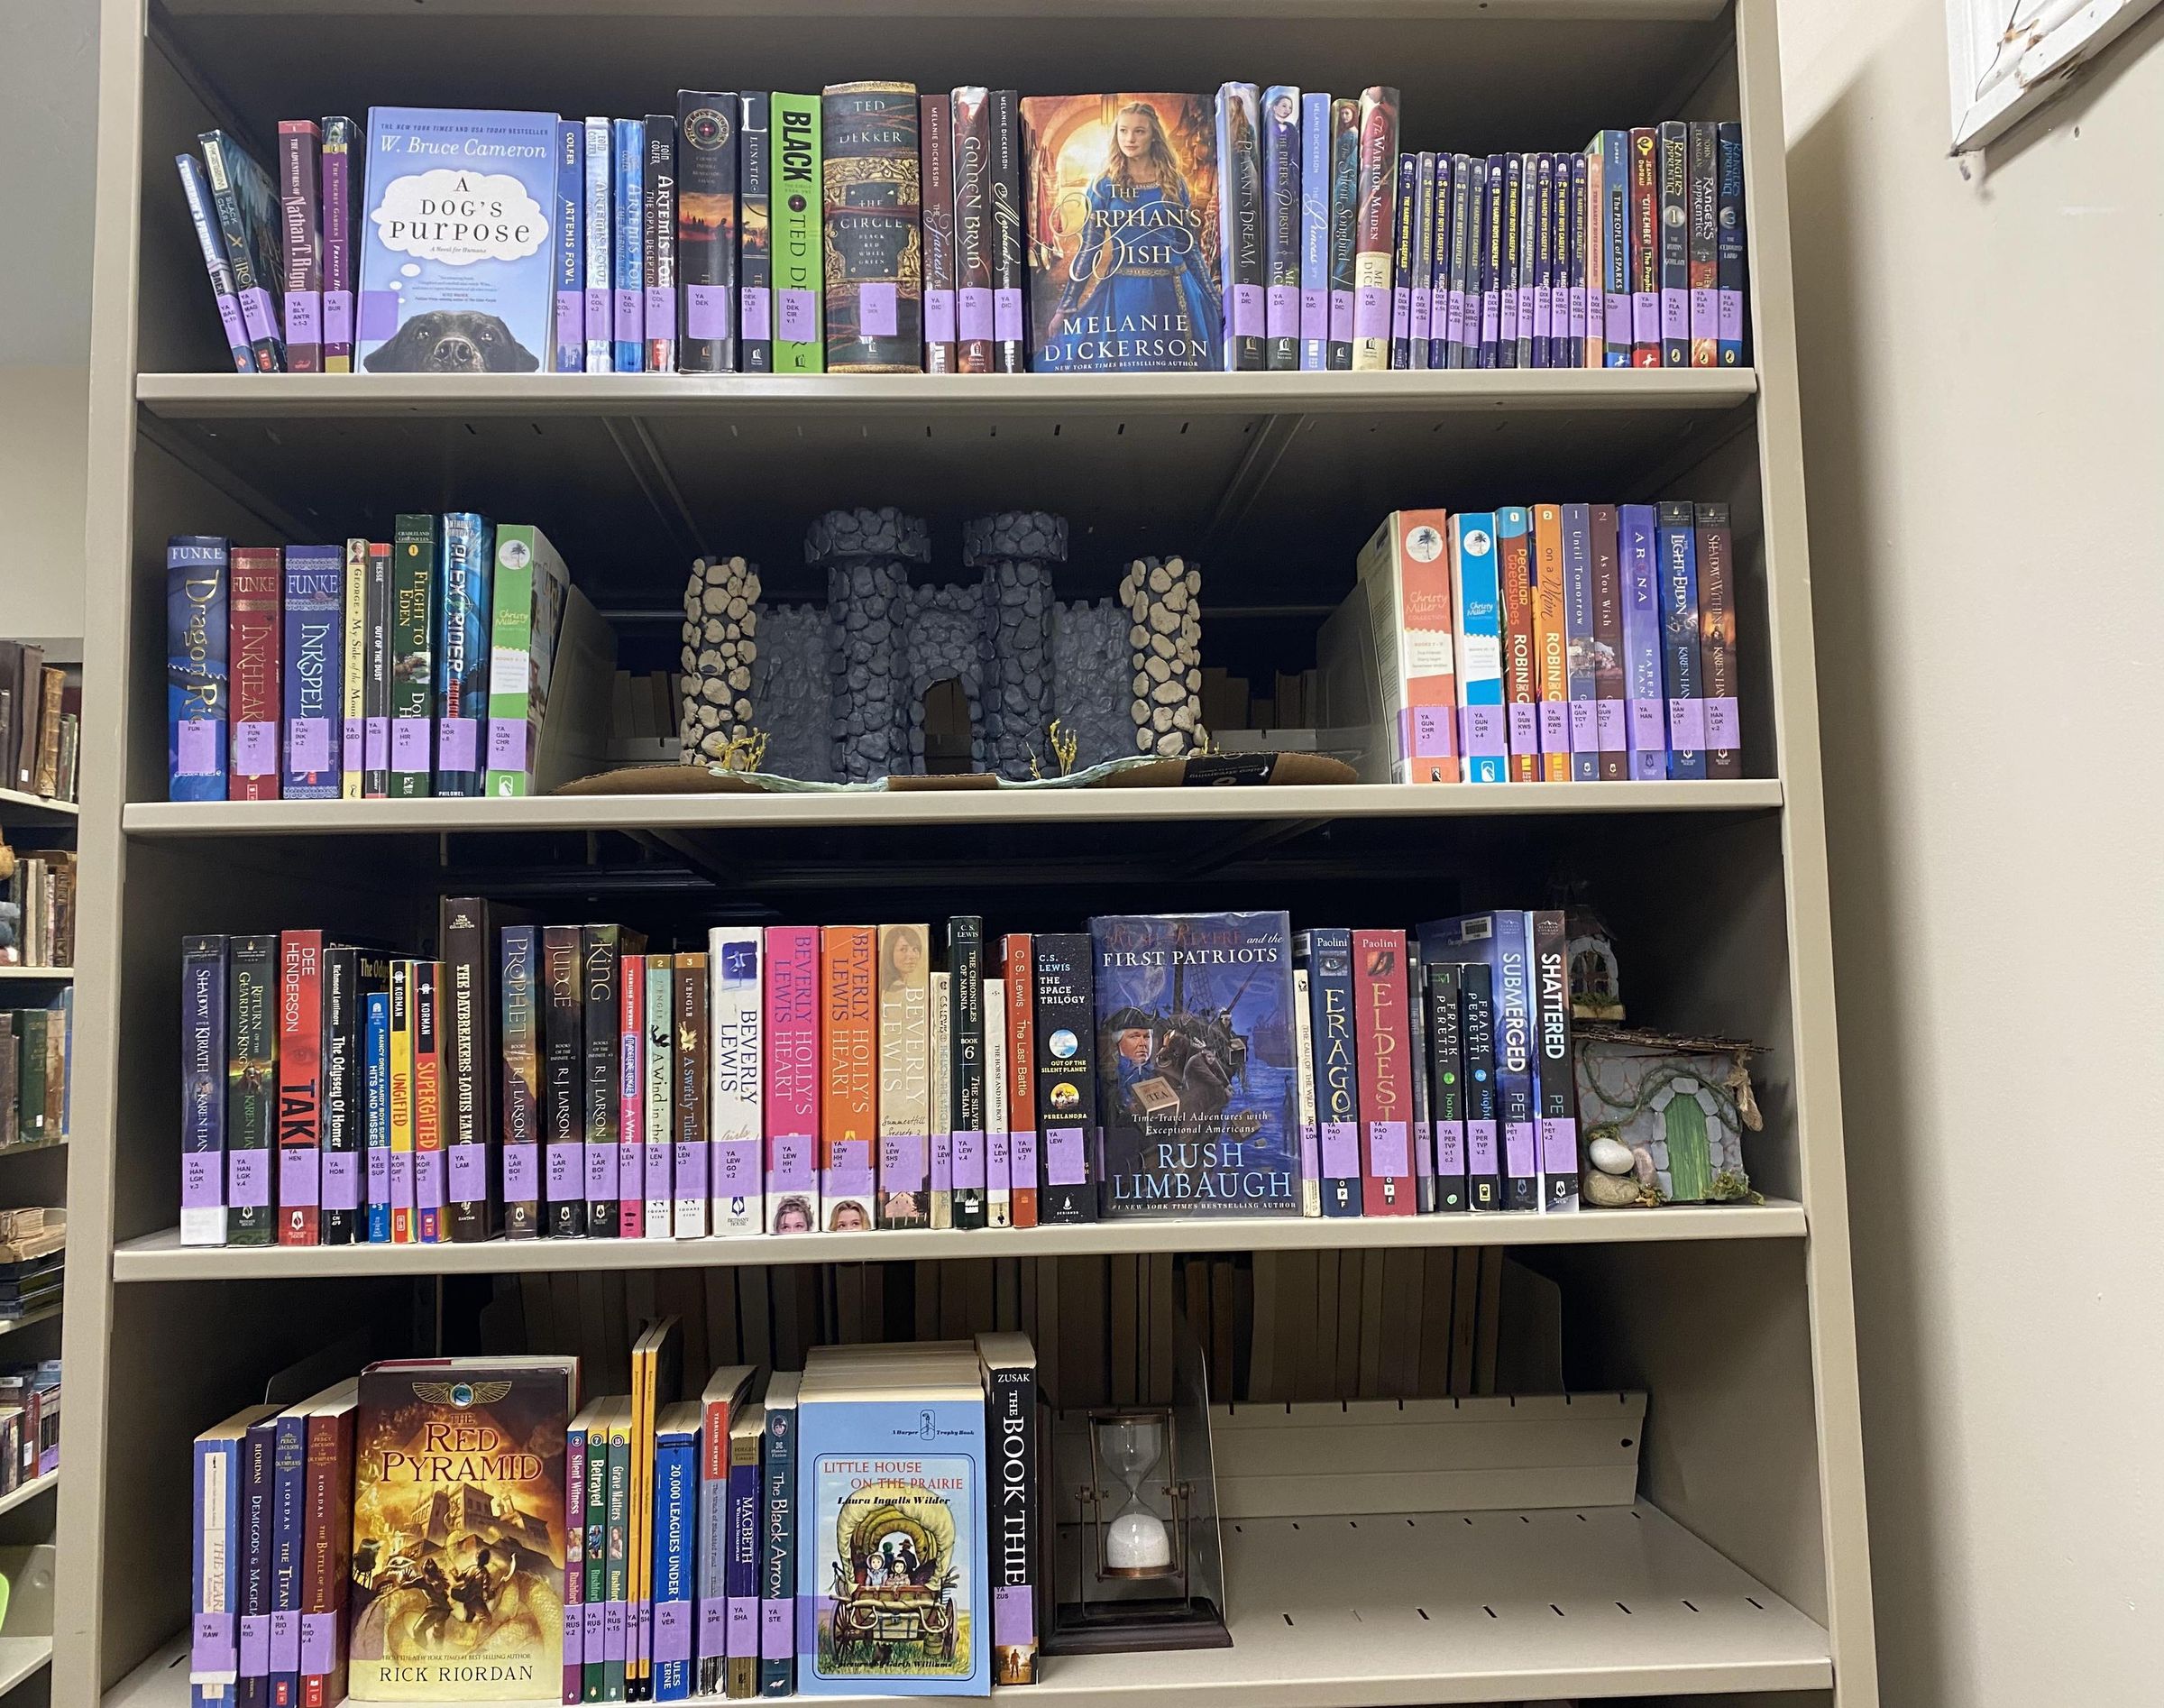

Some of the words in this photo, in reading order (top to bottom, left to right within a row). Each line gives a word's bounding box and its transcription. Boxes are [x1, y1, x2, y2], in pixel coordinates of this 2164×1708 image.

[854, 101, 885, 111] TED
[381, 136, 400, 152] W.
[407, 138, 459, 156] Bruce
[463, 140, 546, 158] Cameron
[783, 110, 812, 181] BLACK
[839, 131, 902, 143] DEKKER
[1372, 135, 1385, 189] WARRIOR
[454, 177, 470, 192] A
[420, 199, 503, 217] DOG'S
[1370, 194, 1379, 241] MAIDEN
[564, 200, 574, 252] ARTEMIS
[789, 219, 806, 257] TED
[840, 218, 903, 229] CIRCLE
[564, 255, 574, 284] FOWL
[1063, 316, 1188, 335] MELANIE
[1044, 341, 1207, 362] DICKERSON
[172, 547, 223, 559] FUNKE
[1573, 531, 1582, 560] Until
[1600, 555, 1608, 568] As
[233, 577, 275, 592] FUNKE
[289, 575, 338, 593] FUNKE
[415, 572, 427, 625] FLIGHT
[1574, 566, 1582, 625] Tomorrow
[184, 569, 220, 676] Dragon
[400, 589, 413, 627] EDEN
[414, 629, 424, 645] TO
[1247, 936, 1264, 944] and
[1267, 935, 1282, 943] the
[1317, 938, 1347, 948] Paolini
[1362, 939, 1397, 948] Paolini
[302, 948, 315, 976] DEE
[961, 964, 967, 976] OF
[1040, 963, 1070, 971] LEWIS
[1104, 952, 1164, 967] FIRST
[1172, 948, 1277, 964] PATRIOTS
[286, 943, 298, 1032] HENDERSON
[507, 939, 528, 1040] PROPHET
[775, 960, 791, 1022] LEWIS
[795, 937, 811, 1024] BEVERLY
[833, 959, 848, 1021] LEWIS
[852, 933, 867, 1021] BEVERLY
[395, 984, 403, 1016] KORMAN
[1041, 996, 1085, 1004] TRILOGY
[1502, 953, 1525, 1071] SUBMERGED
[1542, 953, 1563, 1059] SHATTERED
[422, 1003, 431, 1035] KORMAN
[334, 1037, 345, 1053] The
[721, 1025, 738, 1091] LEWIS
[740, 1010, 757, 1104] BEVERLY
[883, 1004, 902, 1093] LEWIS
[906, 987, 924, 1106] BEVERLY
[965, 1047, 975, 1059] 6
[332, 1058, 345, 1097] Odyssey
[775, 1033, 792, 1100] HEART
[796, 1031, 812, 1115] HOLLY'S
[833, 1030, 848, 1098] HEART
[853, 1029, 868, 1113] HOLLY'S
[971, 1077, 979, 1093] THE
[333, 1102, 344, 1112] Of
[392, 1074, 407, 1127] UNGIFTED
[417, 1062, 438, 1148] SUPERGIFTED
[559, 1090, 570, 1139] LARSON
[595, 1088, 606, 1137] LARSON
[332, 1115, 344, 1148] Homer
[370, 1106, 378, 1146] MISSES
[1132, 1114, 1185, 1122] Time-Travel
[1190, 1113, 1242, 1121] Adventures
[1247, 1111, 1267, 1120] with
[1146, 1125, 1201, 1134] Exceptional
[1206, 1125, 1255, 1134] Americans
[1158, 1143, 1243, 1168] RUSH
[1114, 1172, 1290, 1199] LIMBAUGH
[998, 1373, 1030, 1382] ZUSAK
[451, 1414, 473, 1423] THE
[1009, 1390, 1018, 1417] THE
[425, 1423, 498, 1452] RED
[381, 1452, 542, 1482] PYRAMID
[572, 1455, 581, 1481] Silent
[824, 1462, 868, 1473] LITTLE
[875, 1462, 922, 1473] HOUSE
[1003, 1418, 1023, 1505] BOOK
[591, 1459, 603, 1507] Betrayed
[612, 1466, 620, 1489] Grave
[670, 1465, 681, 1499] 20,000
[772, 1473, 784, 1496] The
[851, 1478, 871, 1489] ON
[877, 1478, 905, 1489] THE
[911, 1478, 962, 1489] PRAIRIE
[570, 1483, 579, 1514] Witness
[611, 1491, 620, 1520] Matters
[838, 1496, 870, 1505] Laura
[874, 1496, 911, 1505] Ingalls
[913, 1496, 950, 1504] Wilder
[251, 1496, 261, 1554] DEMIGODS
[669, 1501, 680, 1549] LEAGUES
[741, 1496, 753, 1564] MACBETH
[772, 1500, 787, 1550] Black
[668, 1551, 679, 1594] UNDER
[770, 1552, 784, 1600] Arrow
[381, 1667, 427, 1682] RICK
[439, 1667, 533, 1681] RIORDAN
